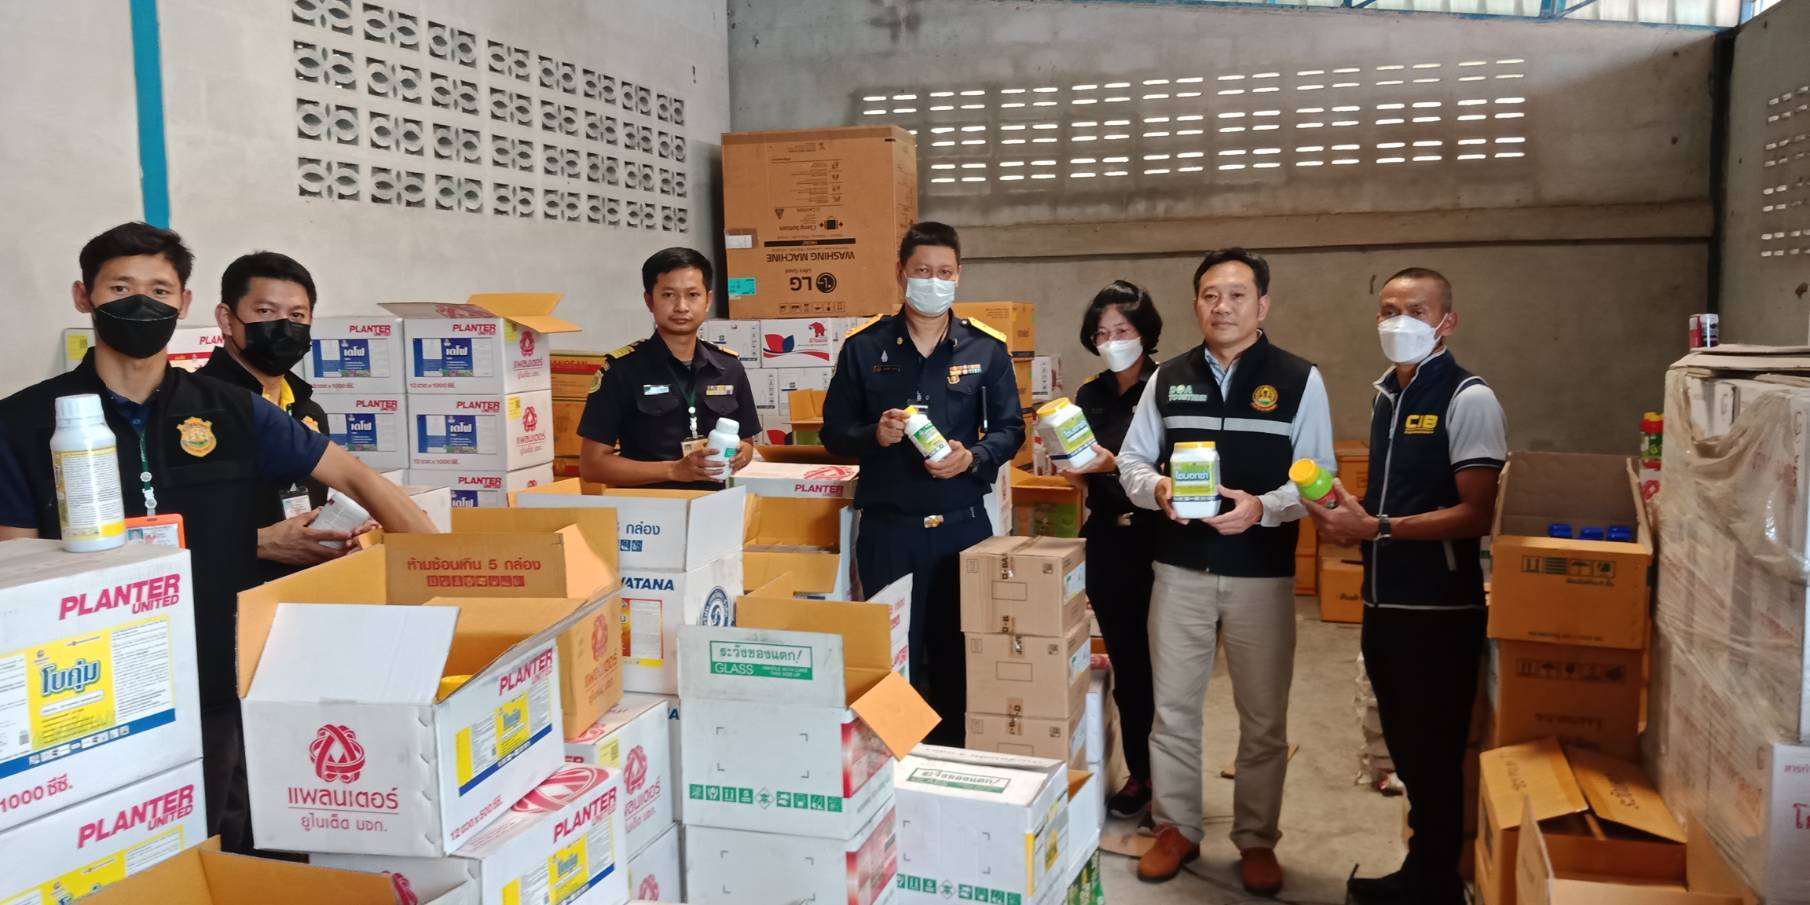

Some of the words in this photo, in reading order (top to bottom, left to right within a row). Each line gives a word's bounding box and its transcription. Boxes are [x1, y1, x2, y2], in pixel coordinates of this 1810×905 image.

[766, 252, 808, 262] MACHINE
[810, 251, 855, 261] WASHING
[790, 276, 812, 291] LG
[350, 325, 391, 334] PLANTER
[452, 324, 496, 333] PLANTER
[356, 400, 398, 408] PLANTER
[456, 401, 500, 410] PLANTER
[1405, 414, 1438, 428] CIB
[458, 476, 502, 485] PLANTER
[794, 484, 843, 494] PLANTER
[625, 520, 661, 536] กล่อง
[489, 559, 498, 570] 5
[504, 556, 542, 571] กล่อง
[59, 573, 181, 620] PLANTER
[132, 594, 180, 615] UNITED
[499, 648, 553, 696] PLANTER
[714, 663, 754, 675] GLASS
[41, 659, 100, 696] โบคุ่ม
[0, 785, 44, 812] 1000
[287, 787, 399, 810] แพลนเตอร์
[77, 784, 194, 849] PLANTER
[149, 804, 193, 831] UNITED
[553, 786, 617, 844] PLANTER
